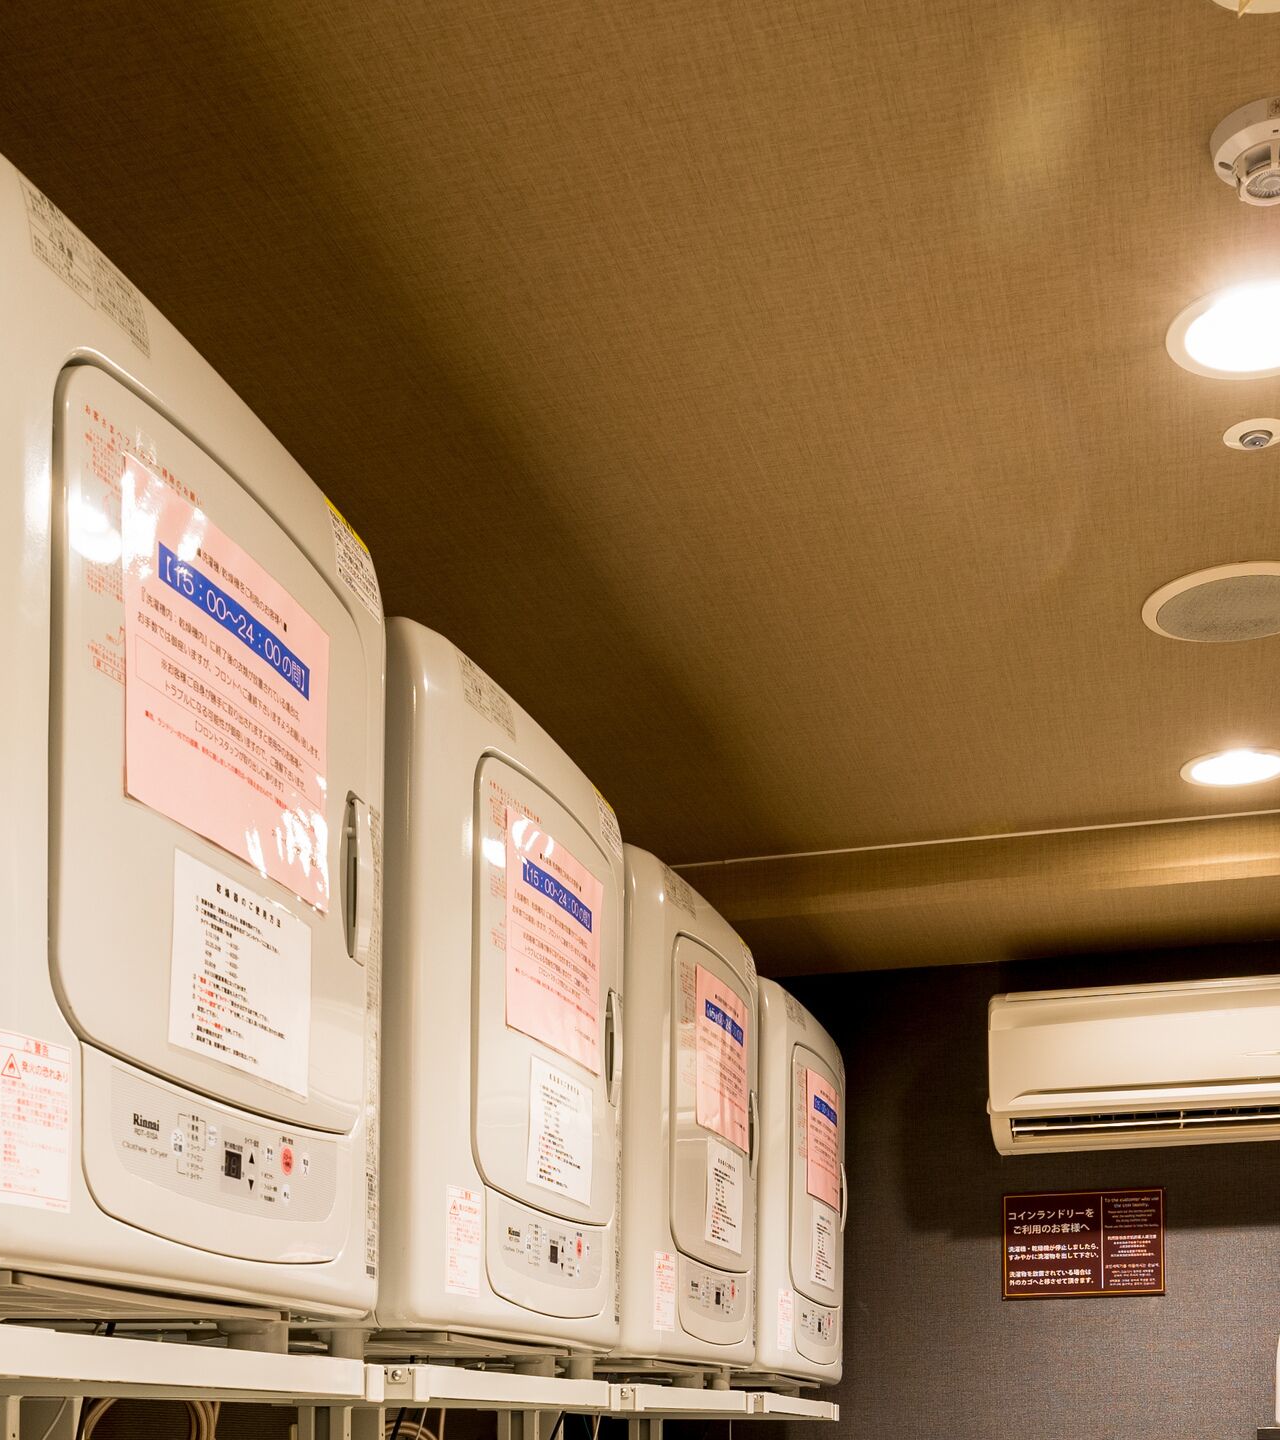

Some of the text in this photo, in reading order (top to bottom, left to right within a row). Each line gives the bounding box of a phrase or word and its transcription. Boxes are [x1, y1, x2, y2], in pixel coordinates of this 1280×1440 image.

[133, 1113, 160, 1132] Rinnai
[1008, 1208, 1094, 1221] コインランドリーを
[1013, 1223, 1091, 1235] ご利用のお客様へ
